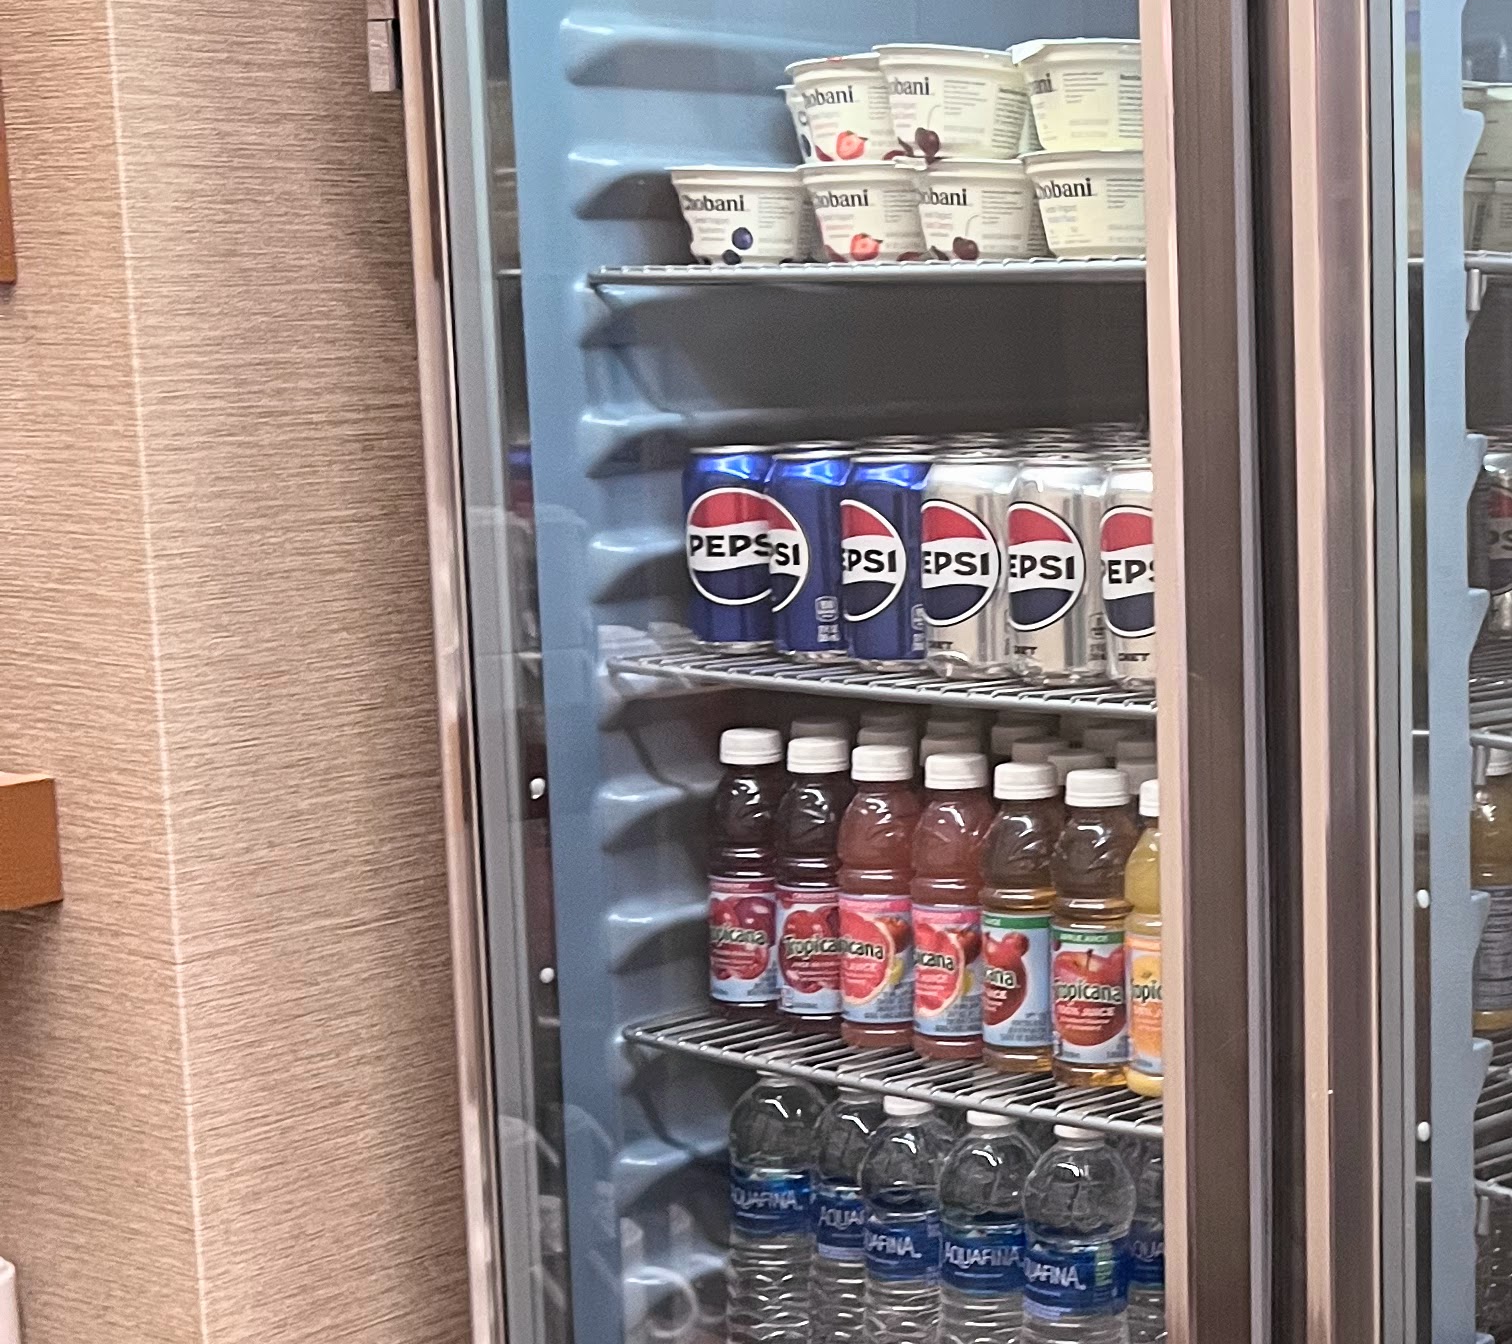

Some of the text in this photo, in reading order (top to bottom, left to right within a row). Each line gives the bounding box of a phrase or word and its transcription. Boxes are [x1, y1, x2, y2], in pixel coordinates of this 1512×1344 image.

[690, 532, 773, 557] PEPS
[922, 551, 990, 577] EPSI
[1009, 554, 1075, 580] EPSI
